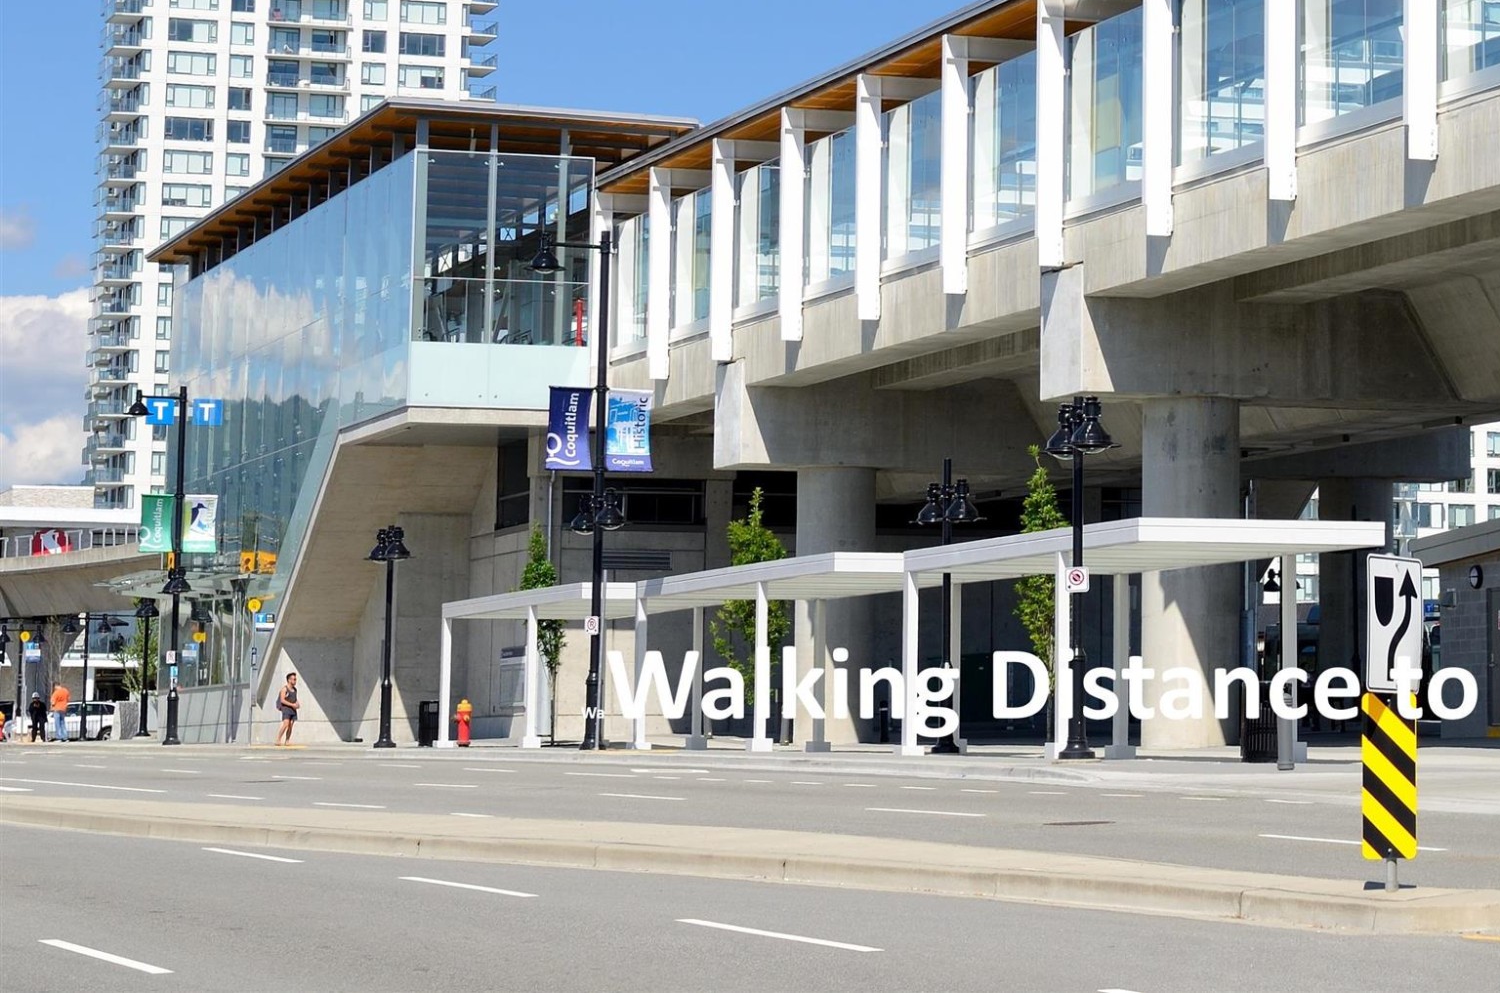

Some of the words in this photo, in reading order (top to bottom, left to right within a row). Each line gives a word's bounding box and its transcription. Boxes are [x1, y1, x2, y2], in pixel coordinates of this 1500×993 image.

[153, 401, 169, 420] T
[565, 393, 579, 457] Coquitlam
[633, 397, 648, 449] Historic
[153, 498, 164, 543] Coquitlam
